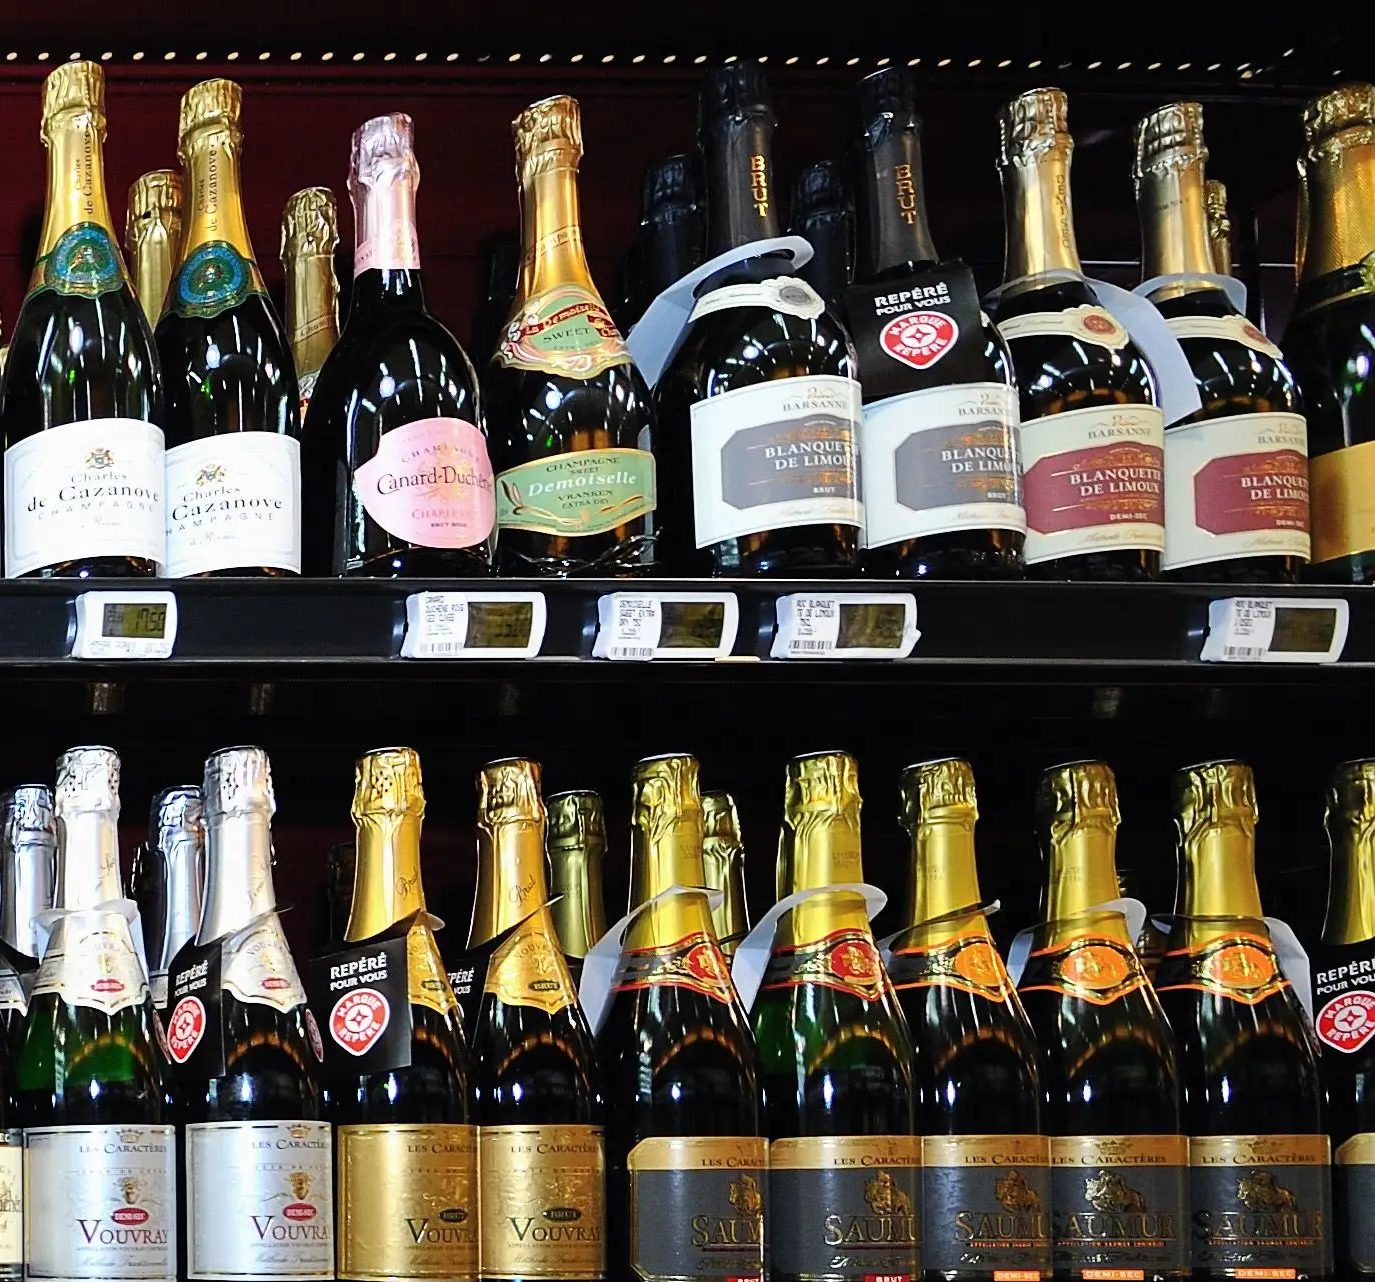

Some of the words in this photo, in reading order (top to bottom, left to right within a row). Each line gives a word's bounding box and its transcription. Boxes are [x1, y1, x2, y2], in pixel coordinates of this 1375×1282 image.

[750, 154, 768, 218] BRUT
[895, 164, 917, 224] BRUT
[874, 281, 949, 307] REPÉRÉ
[876, 302, 914, 316] POUR
[914, 295, 951, 309] VOUS
[543, 327, 590, 343] SWEET
[889, 314, 946, 336] MARQUE
[546, 453, 620, 474] CHAMPAGNE
[774, 456, 799, 470] DE
[57, 484, 160, 502] Cazanove
[528, 471, 637, 497] Demoiselle
[813, 486, 836, 495] BRUT
[1080, 483, 1104, 497] DE
[1109, 481, 1160, 495] LIMOUX
[1109, 513, 1148, 521] DEMI-SEC
[330, 952, 387, 979] REPÉRÉ
[330, 977, 358, 991] POUR
[359, 970, 387, 984] VOUS
[337, 994, 382, 1018] MARQUE
[1053, 1155, 1077, 1164] LES
[875, 1275, 903, 1282] BRUT
[1086, 1270, 1140, 1279] DEMI-SEC
